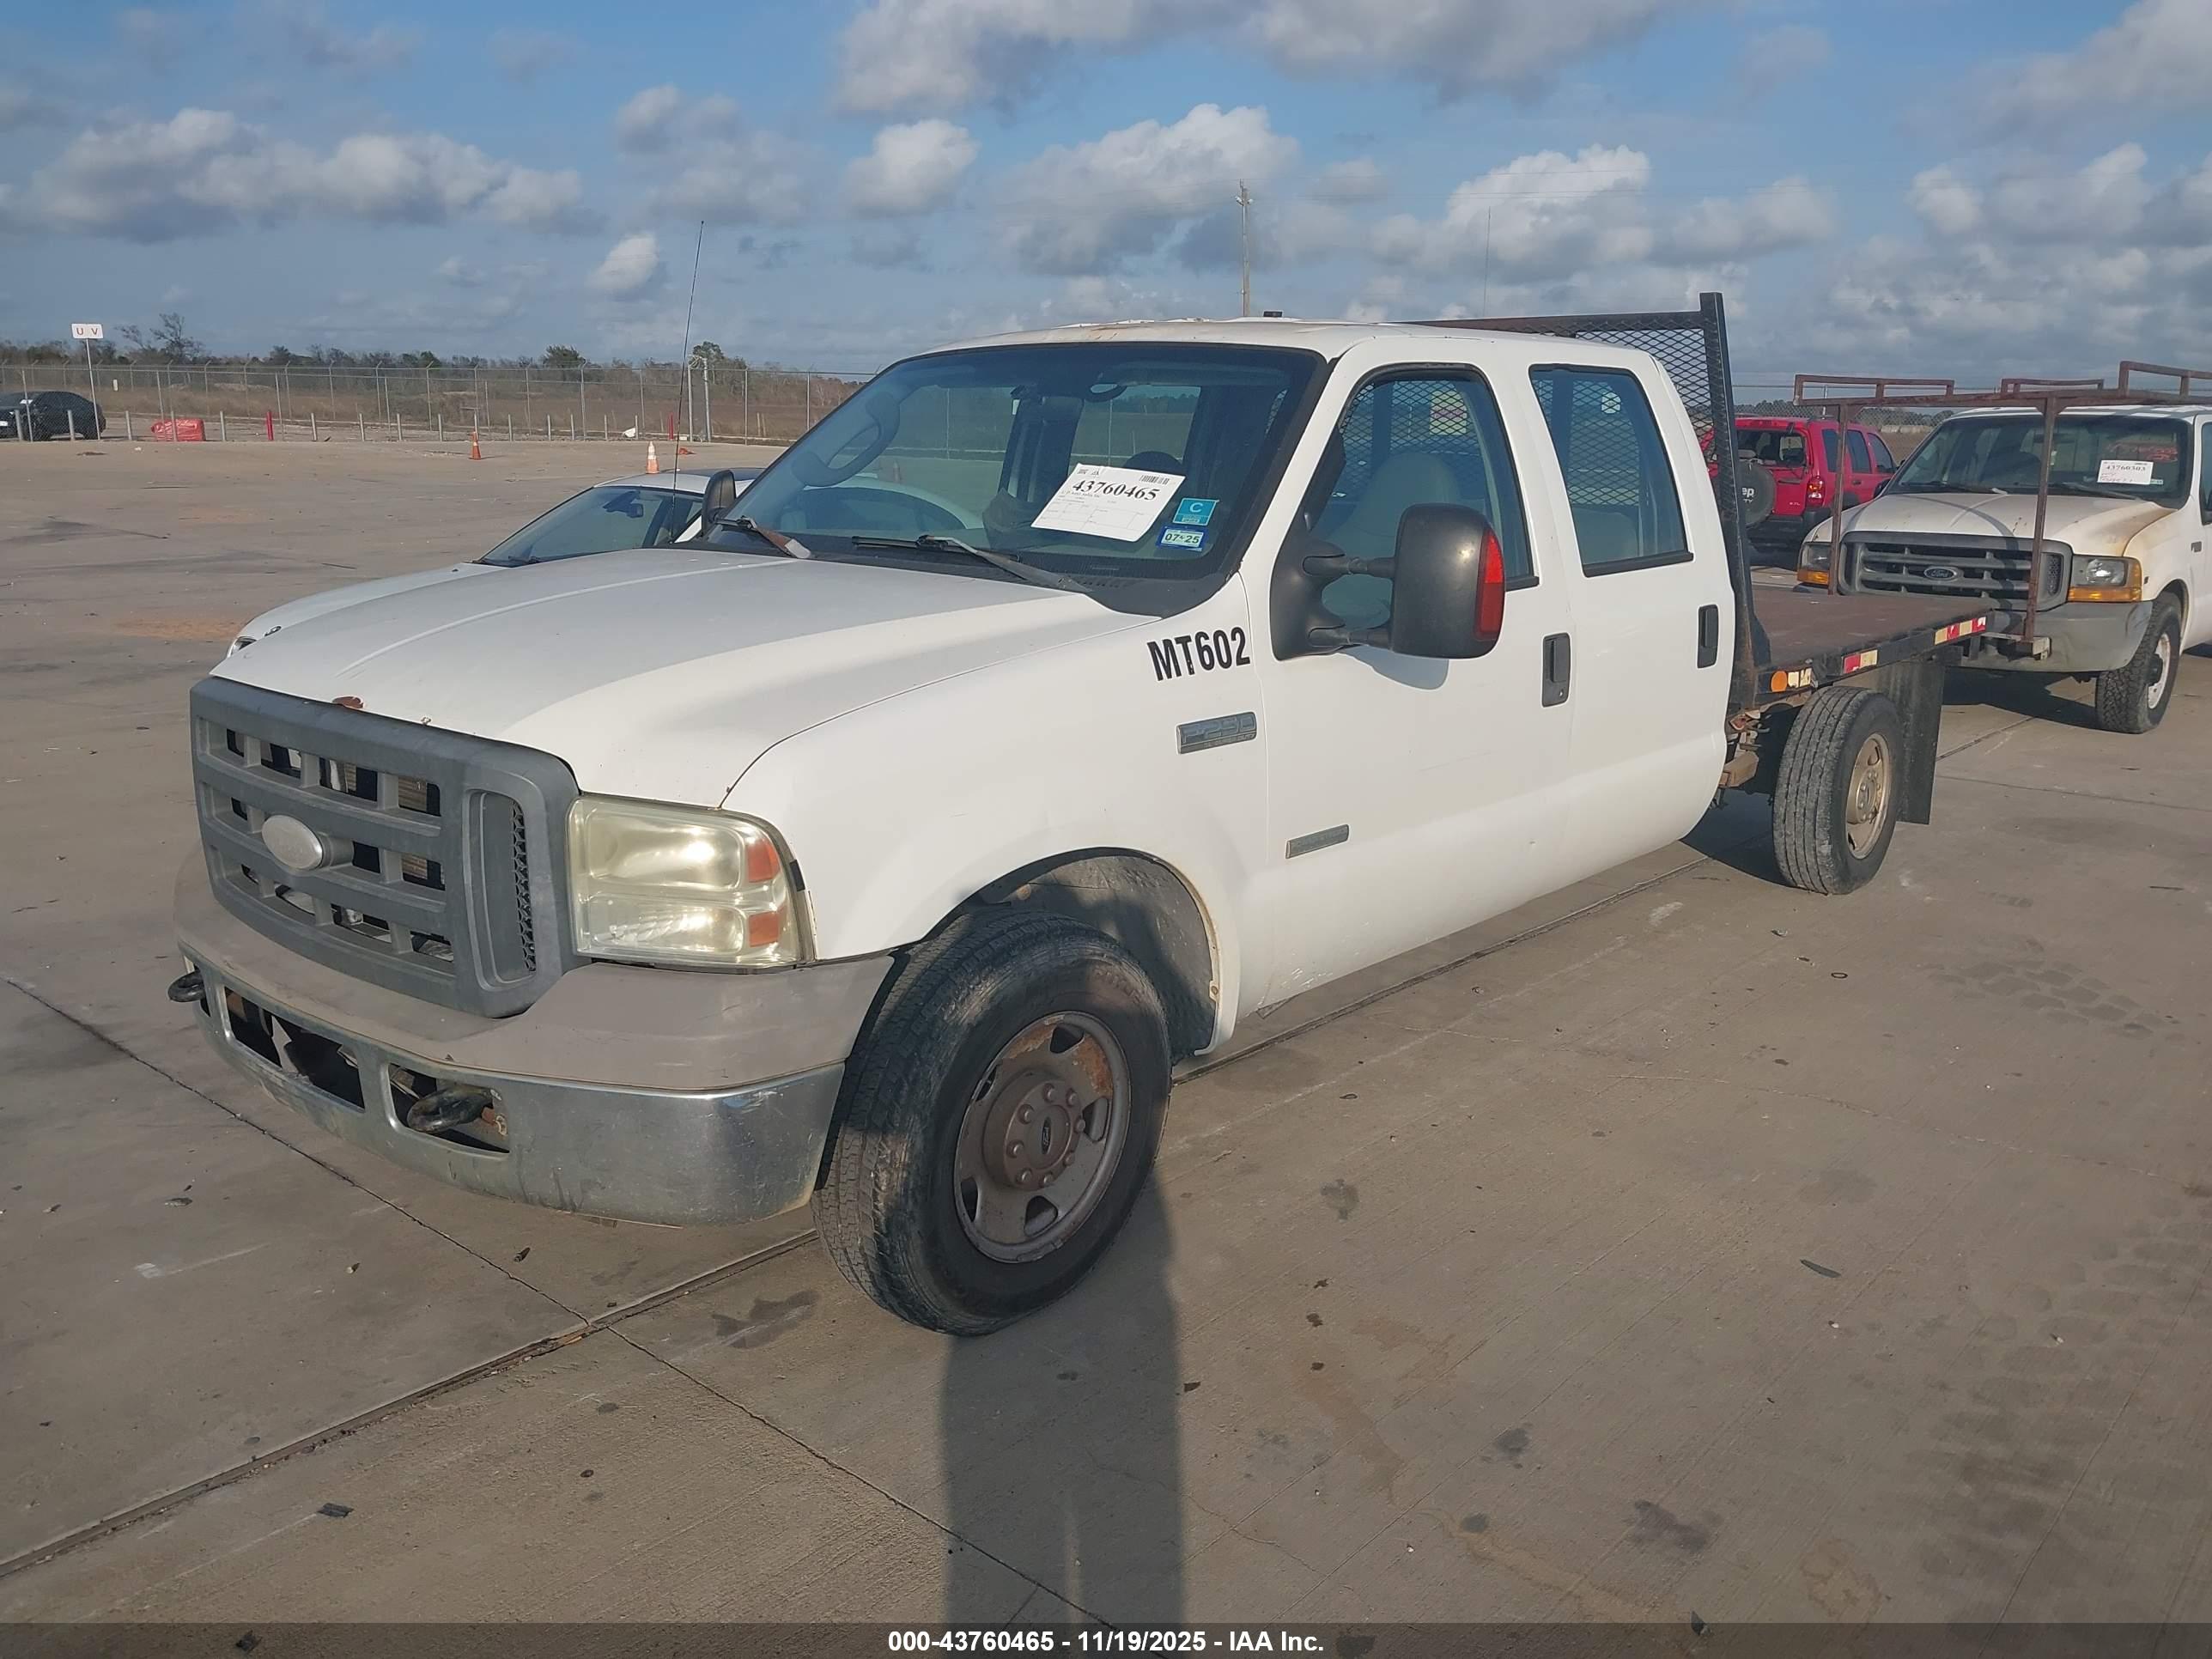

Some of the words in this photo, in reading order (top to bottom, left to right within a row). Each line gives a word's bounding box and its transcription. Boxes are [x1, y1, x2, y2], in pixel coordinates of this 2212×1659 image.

[1073, 479, 1161, 501] 43760465
[1741, 487, 1755, 498] ep
[1189, 502, 1204, 514] C
[1146, 626, 1251, 682] MT602
